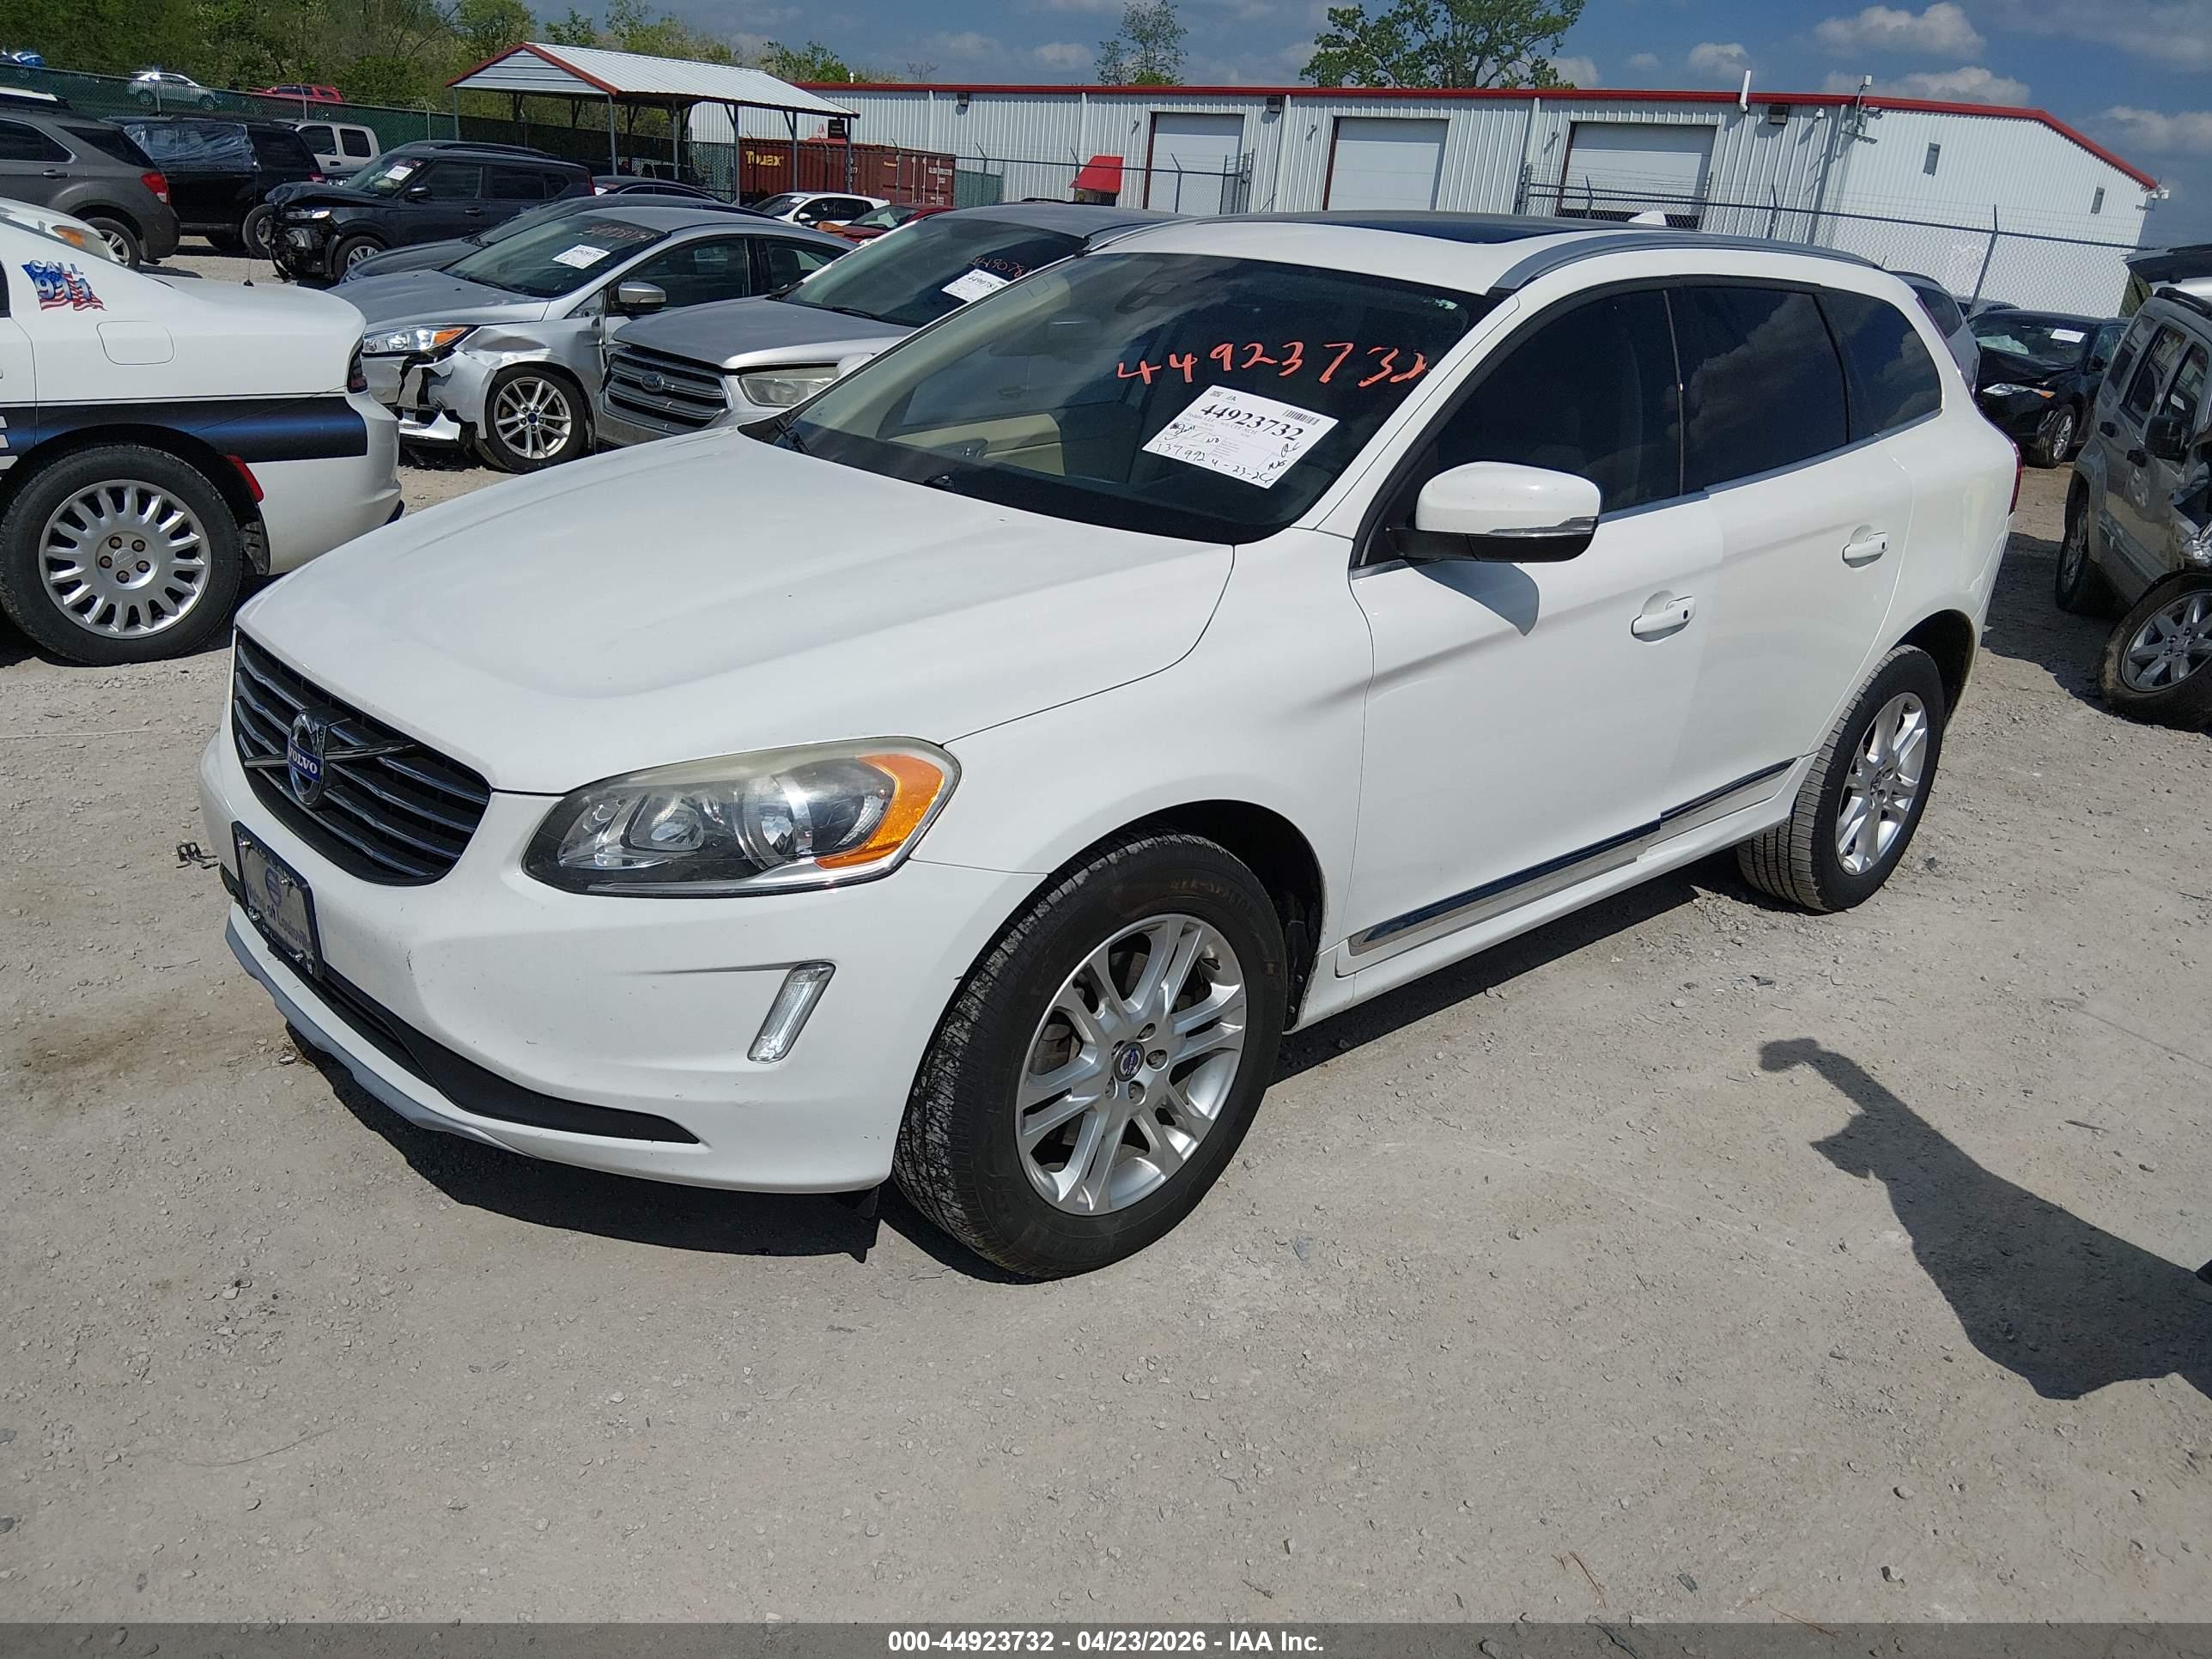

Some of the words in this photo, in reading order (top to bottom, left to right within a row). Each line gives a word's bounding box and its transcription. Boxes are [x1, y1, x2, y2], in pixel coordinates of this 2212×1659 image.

[29, 259, 84, 276] CALL
[34, 276, 91, 301] 911
[1200, 404, 1304, 441] 44923732
[289, 747, 318, 775] VOLVO
